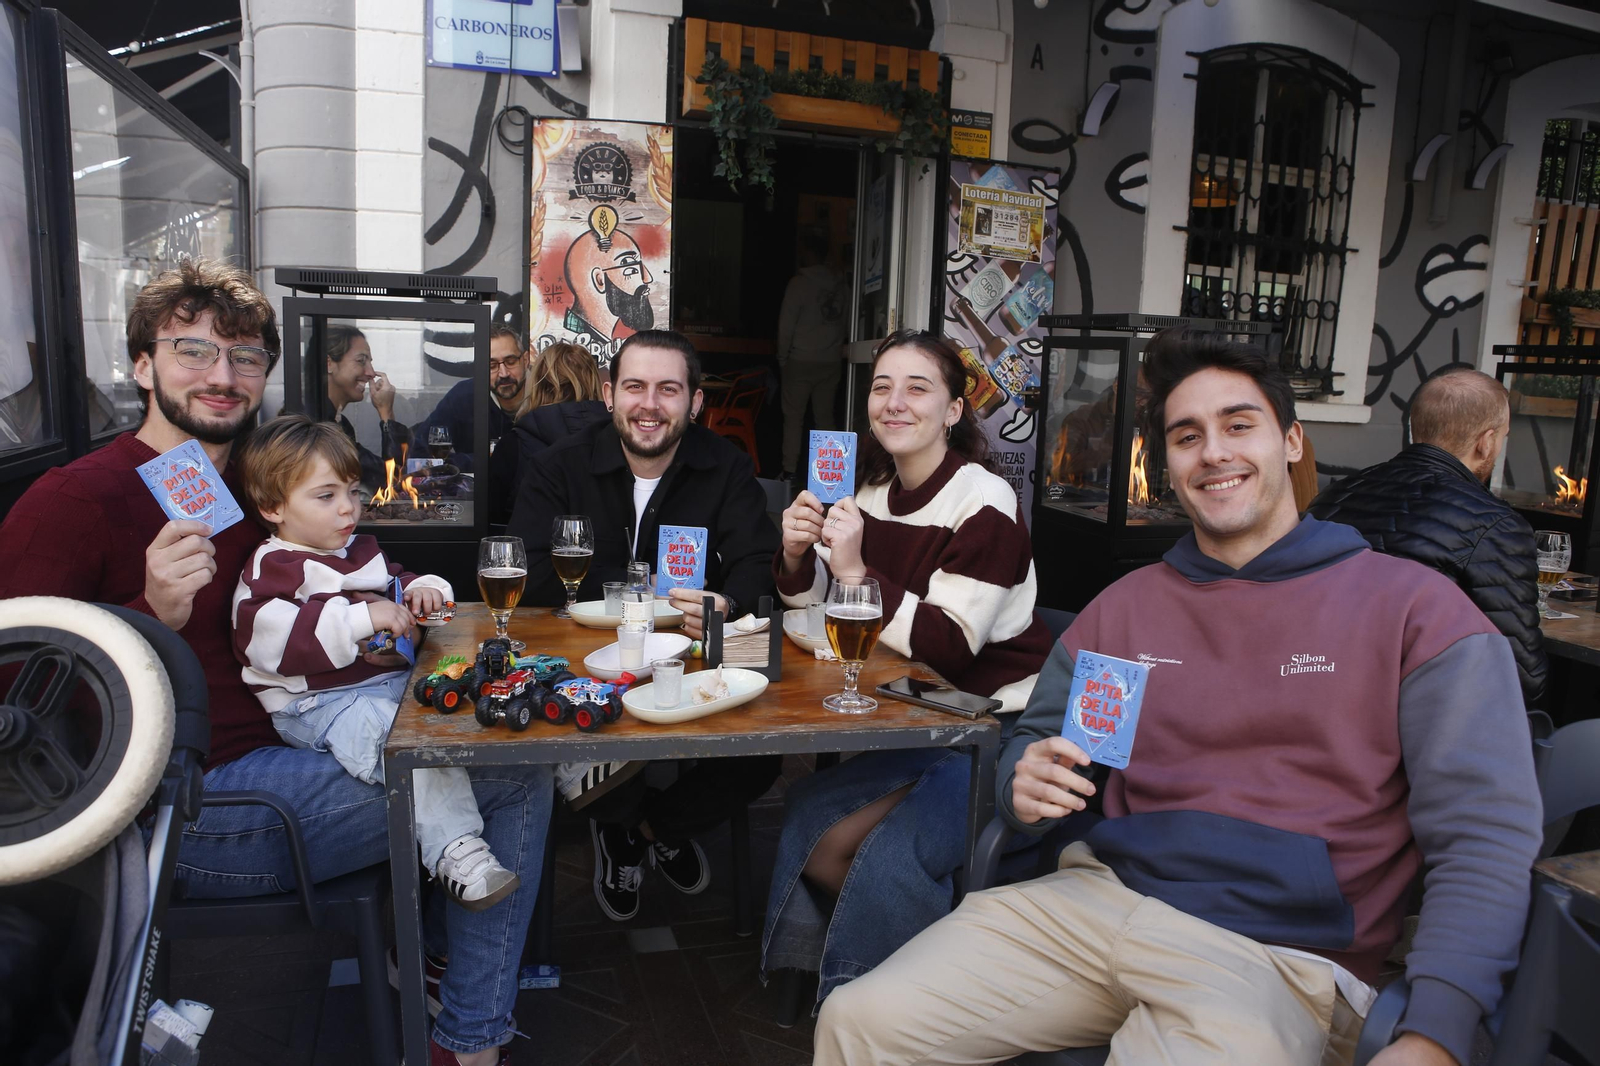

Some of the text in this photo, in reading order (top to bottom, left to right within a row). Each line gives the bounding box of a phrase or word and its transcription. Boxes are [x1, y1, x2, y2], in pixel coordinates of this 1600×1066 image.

[434, 16, 553, 41] CARBONEROS
[953, 131, 988, 139] CONECTADA
[581, 150, 625, 169] BARBAS
[580, 185, 596, 194] FOOD
[603, 185, 626, 196] DRINKS
[965, 186, 1042, 208] Lotería Navidad
[993, 211, 1019, 222] 31284
[979, 277, 998, 298] CIRO
[818, 448, 844, 459] RUTA
[989, 452, 1026, 465] ERVEZAS
[816, 459, 845, 471] DE LA
[163, 466, 201, 492] RUTA
[818, 471, 843, 482] TAPA
[170, 478, 211, 506] DE LA
[181, 492, 218, 516] TAPA
[668, 543, 695, 554] RUTA
[666, 554, 696, 565] DE LA
[668, 565, 694, 577] TAPA
[1290, 653, 1327, 666] Silbon
[1280, 662, 1335, 677] Unlimited
[1085, 679, 1123, 702] RUTA
[1080, 695, 1122, 719] DE LA
[1080, 712, 1116, 735] TAPA
[132, 926, 162, 1034] TWISTSHAKE
